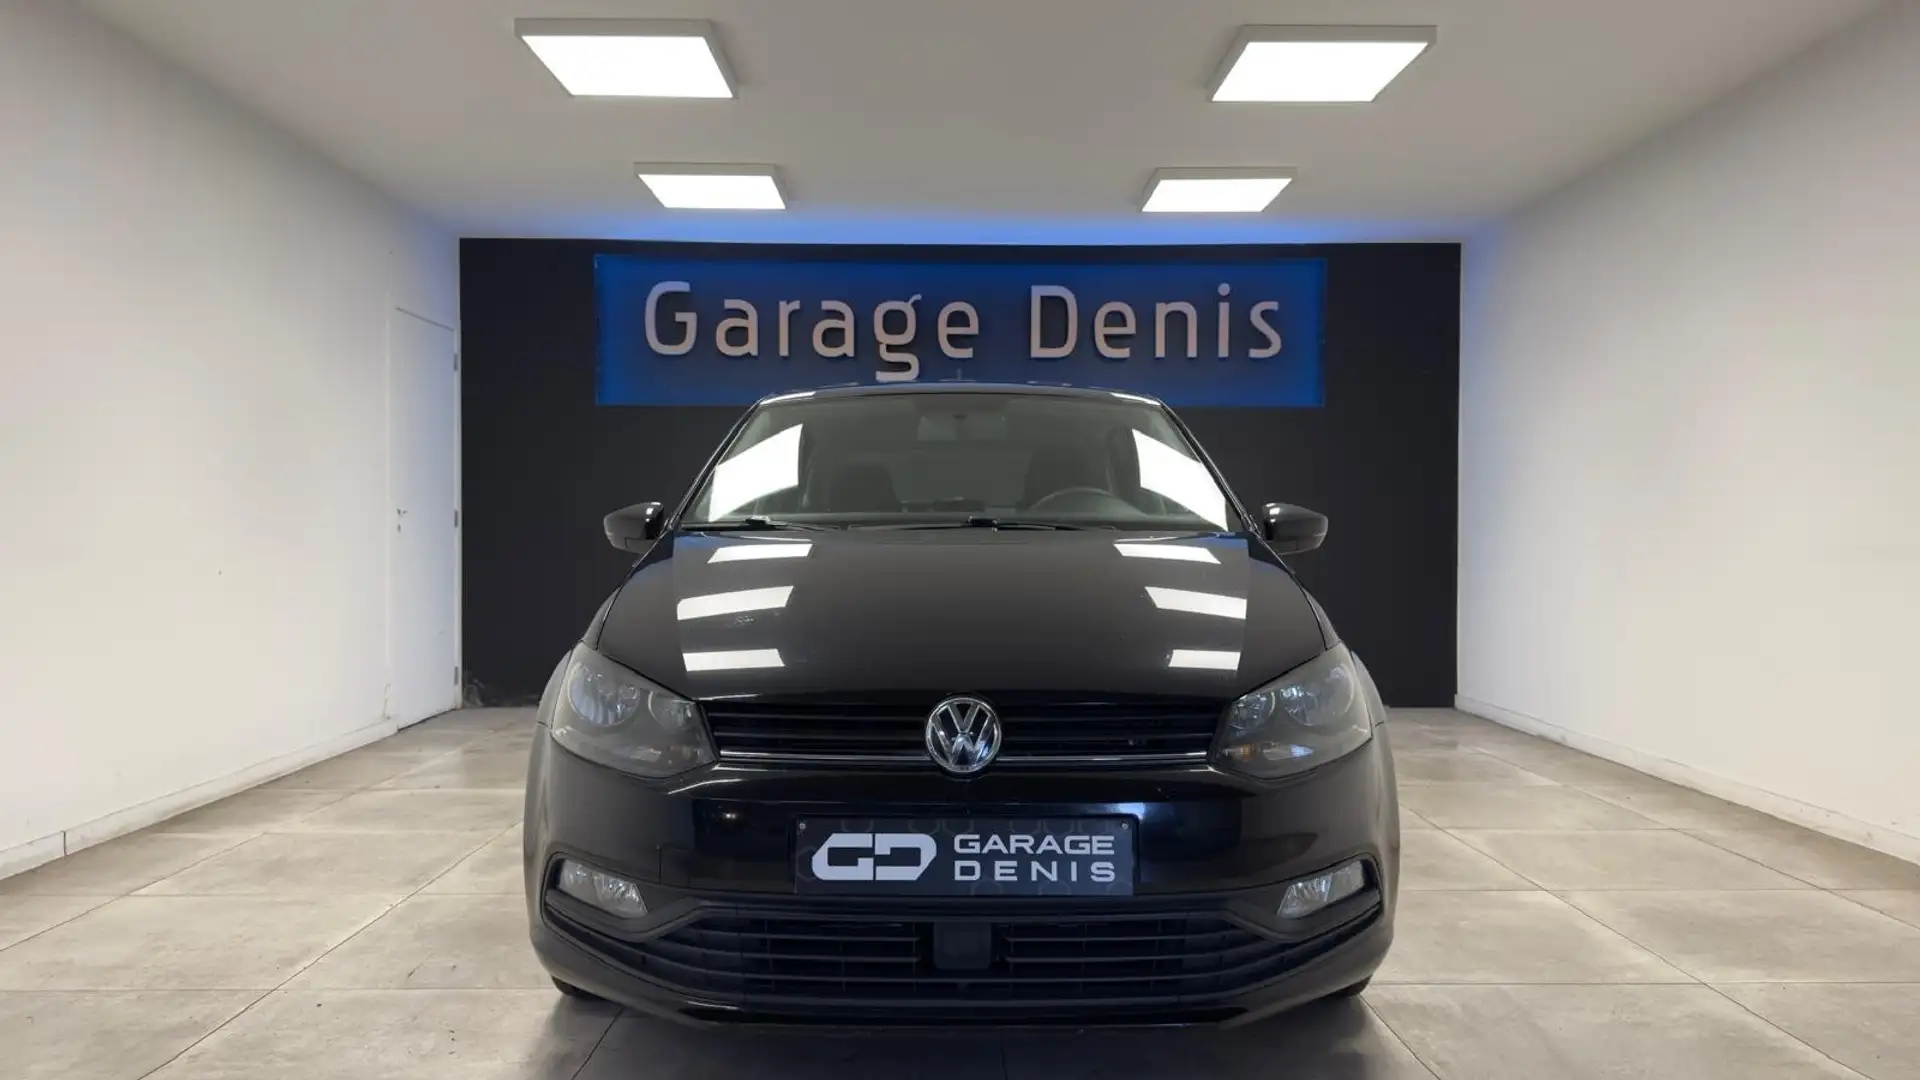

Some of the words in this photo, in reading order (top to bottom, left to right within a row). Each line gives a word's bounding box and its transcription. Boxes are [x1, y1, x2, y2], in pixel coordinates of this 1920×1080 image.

[643, 280, 980, 382] Garage
[1028, 283, 1284, 360] Denis
[953, 834, 1115, 855] GARAGE
[954, 860, 1116, 882] DENIS
